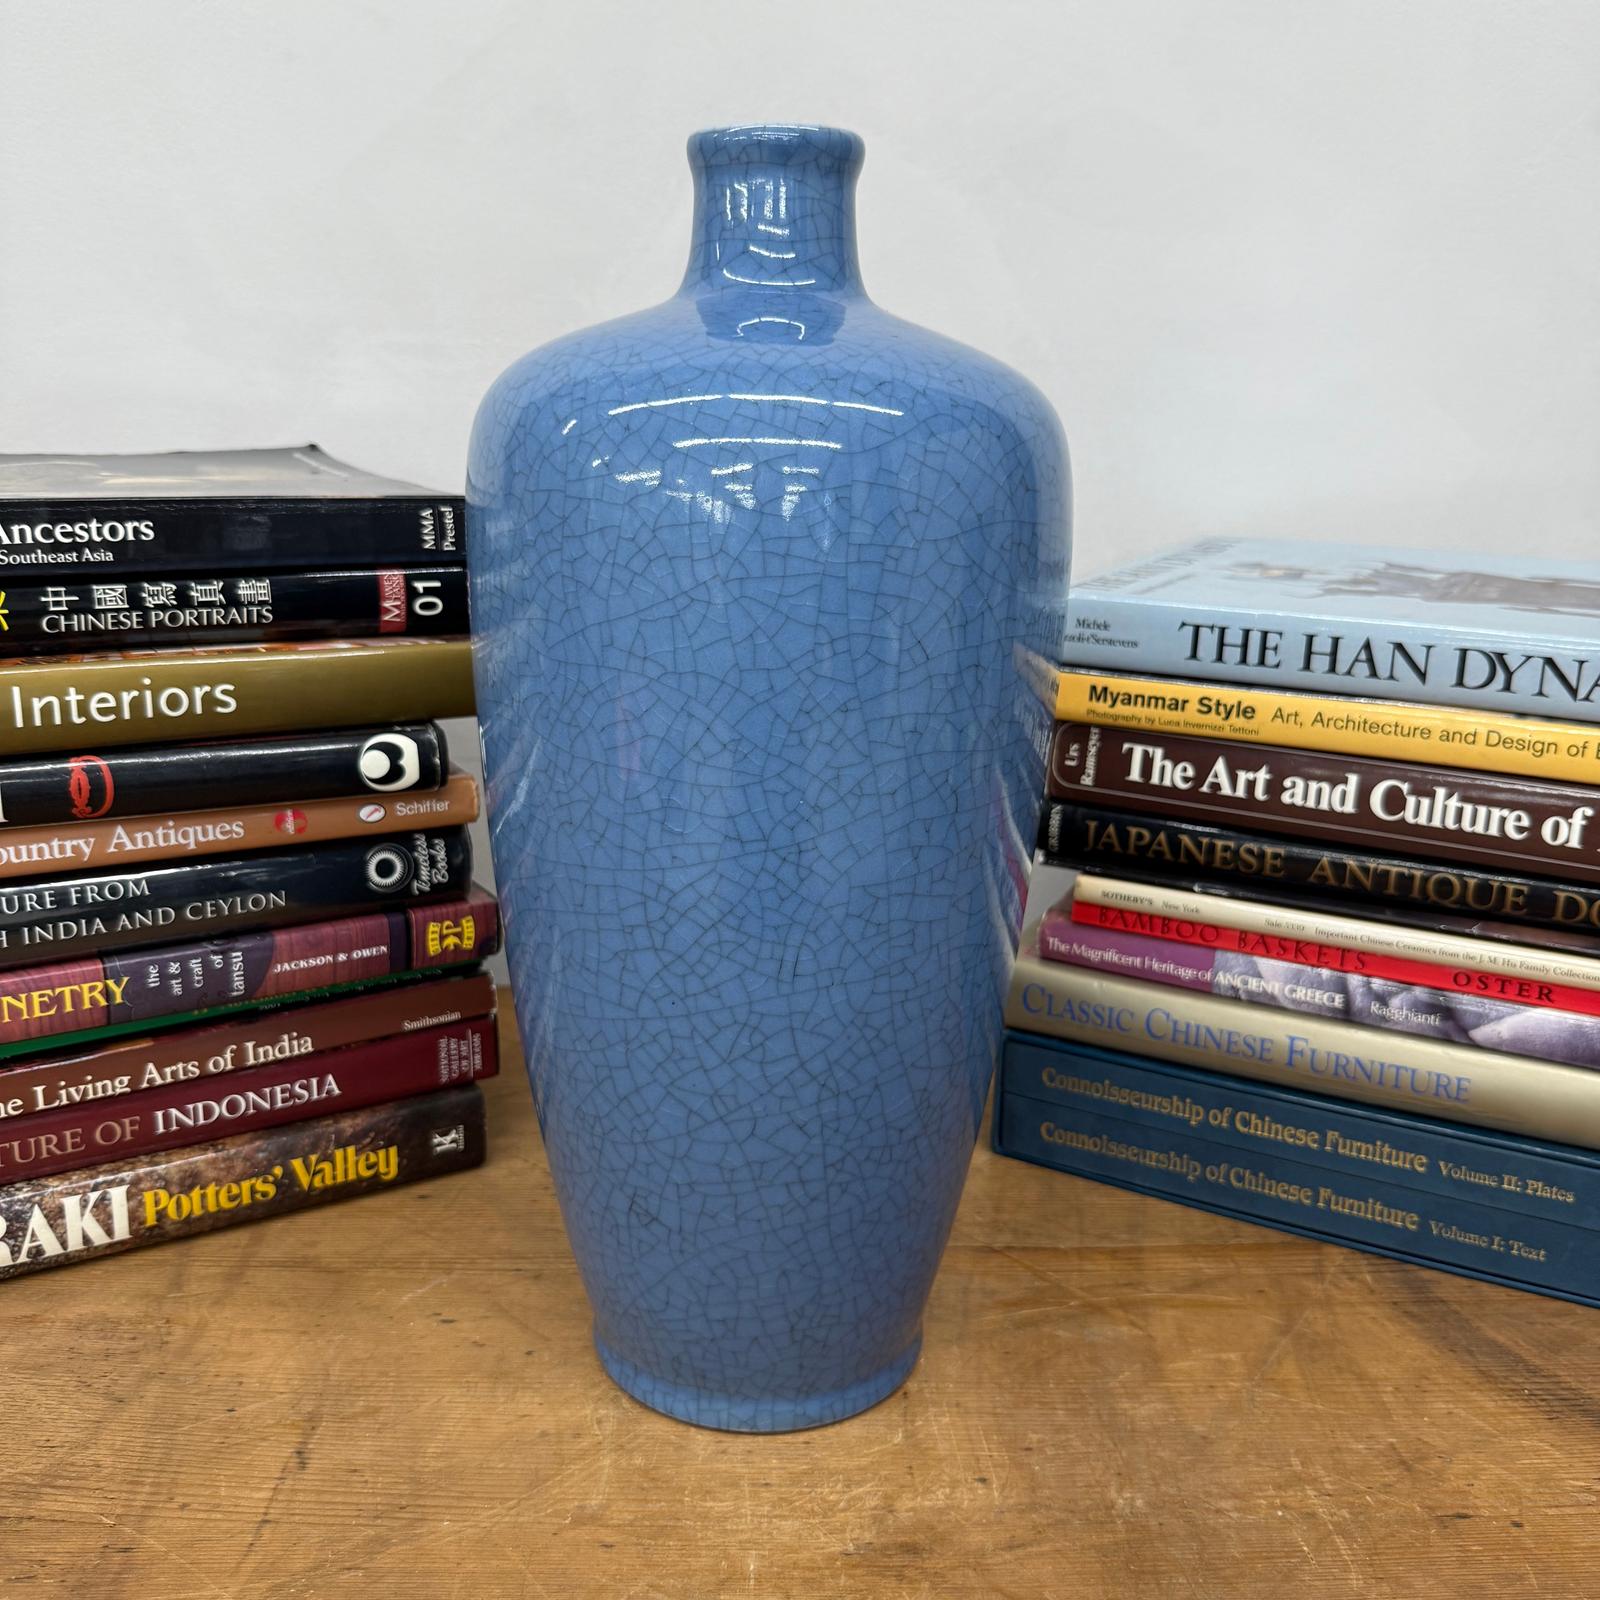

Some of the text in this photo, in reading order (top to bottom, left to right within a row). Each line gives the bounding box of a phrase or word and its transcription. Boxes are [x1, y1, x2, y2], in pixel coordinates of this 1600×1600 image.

[421, 508, 436, 550] MMA
[440, 506, 457, 551] Prestel
[0, 547, 114, 565] Southeast Asia
[42, 606, 273, 633] CHINESE PORTRAITS
[413, 581, 444, 616] 01
[1178, 621, 1284, 669] THE
[1297, 632, 1437, 686] HAN
[12, 677, 238, 728] Interiors
[1086, 708, 1142, 725] Photography
[1144, 715, 1156, 726] by
[1158, 717, 1181, 728] Luca
[1228, 724, 1260, 736] Tettoni
[1088, 684, 1256, 720] Myanmar Style
[1064, 742, 1081, 767] Urs
[1271, 707, 1303, 729] Art,
[1311, 711, 1433, 741] Architecture
[1438, 724, 1478, 746] and
[1484, 730, 1558, 758] Design
[1566, 741, 1589, 758] of
[396, 800, 450, 816] Schiffer
[1121, 742, 1594, 851] The Art and Culture of
[106, 820, 245, 853] Antiques
[411, 833, 431, 896] Timeless
[430, 838, 449, 885] Books
[1085, 820, 1287, 879] JAPANESE
[1309, 857, 1528, 916] ANTIQUE
[70, 879, 151, 905] FROM
[23, 917, 108, 945] INDIA
[117, 907, 175, 931] AND
[186, 890, 287, 921] CEYLON
[1101, 890, 1153, 905] SOTHEBY'S
[1162, 900, 1179, 911] New
[1182, 903, 1200, 914] York
[1315, 926, 1358, 941] Important
[1360, 933, 1395, 946] Chinese
[1396, 940, 1437, 954] Ceramics
[1438, 948, 1460, 959] from
[1462, 951, 1477, 961] the
[1519, 960, 1552, 975] Family
[1553, 965, 1600, 982] Collection
[147, 964, 160, 987] the
[190, 957, 203, 988] craft
[210, 955, 223, 968] of
[231, 951, 245, 997] tansu
[273, 945, 389, 974] JACKSON & OWEN
[1098, 907, 1555, 1003] BAMBOO BASKETS OSTER
[1, 977, 130, 1022] NETRY
[169, 961, 182, 996] art &
[1047, 936, 1442, 1027] The Magnificent Heritage of ANCIENT GREECE Ragghianti
[404, 1010, 461, 1031] Smithsonian
[1022, 982, 1471, 1101] CLASSIC CHINESE FURNITURE
[33, 1075, 131, 1112] Living
[141, 1062, 200, 1089] Arts
[208, 1045, 237, 1073] of
[244, 1032, 315, 1066] India
[95, 1116, 140, 1145] OF
[153, 1073, 342, 1135] INDONESIA
[1041, 1066, 1204, 1127] Connoisseurship
[1208, 1104, 1231, 1128] of
[1234, 1109, 1319, 1150] Chinese
[1325, 1130, 1429, 1173] Furniture
[1438, 1160, 1498, 1189] Volume
[1525, 1178, 1575, 1203] Plates
[143, 1166, 284, 1227] Potters'
[291, 1144, 399, 1190] Valley
[1040, 1121, 1201, 1182] Connoisseurship
[1206, 1160, 1229, 1183] of
[1230, 1165, 1312, 1205] Chinese
[1318, 1185, 1419, 1230] Furniture
[1429, 1218, 1489, 1248] Volume
[1508, 1235, 1548, 1263] Text
